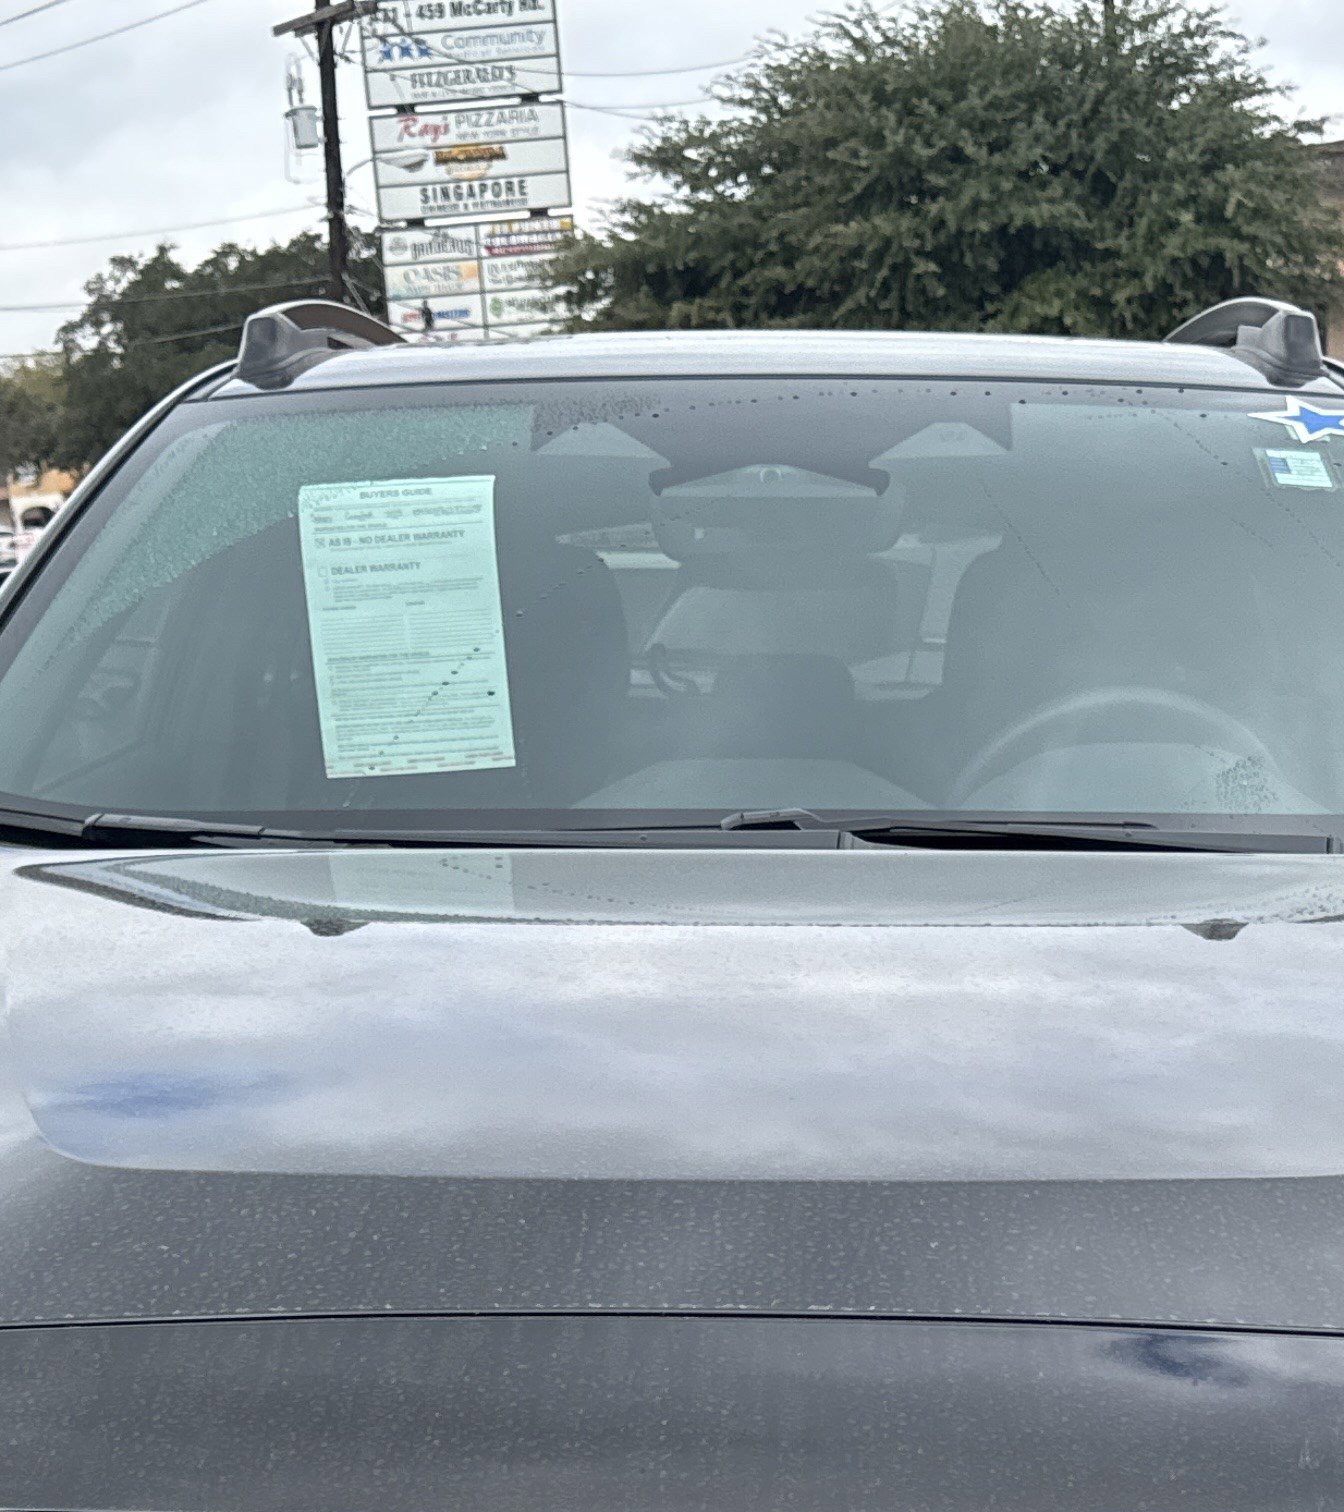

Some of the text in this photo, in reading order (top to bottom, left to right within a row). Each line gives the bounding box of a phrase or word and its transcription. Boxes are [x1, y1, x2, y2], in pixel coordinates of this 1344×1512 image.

[441, 29, 546, 49] Community
[420, 179, 528, 204] SINGAPORE
[375, 531, 410, 544] DEALER
[414, 529, 465, 541] WARRANTY
[331, 561, 421, 576] DEALER WARRANTY
